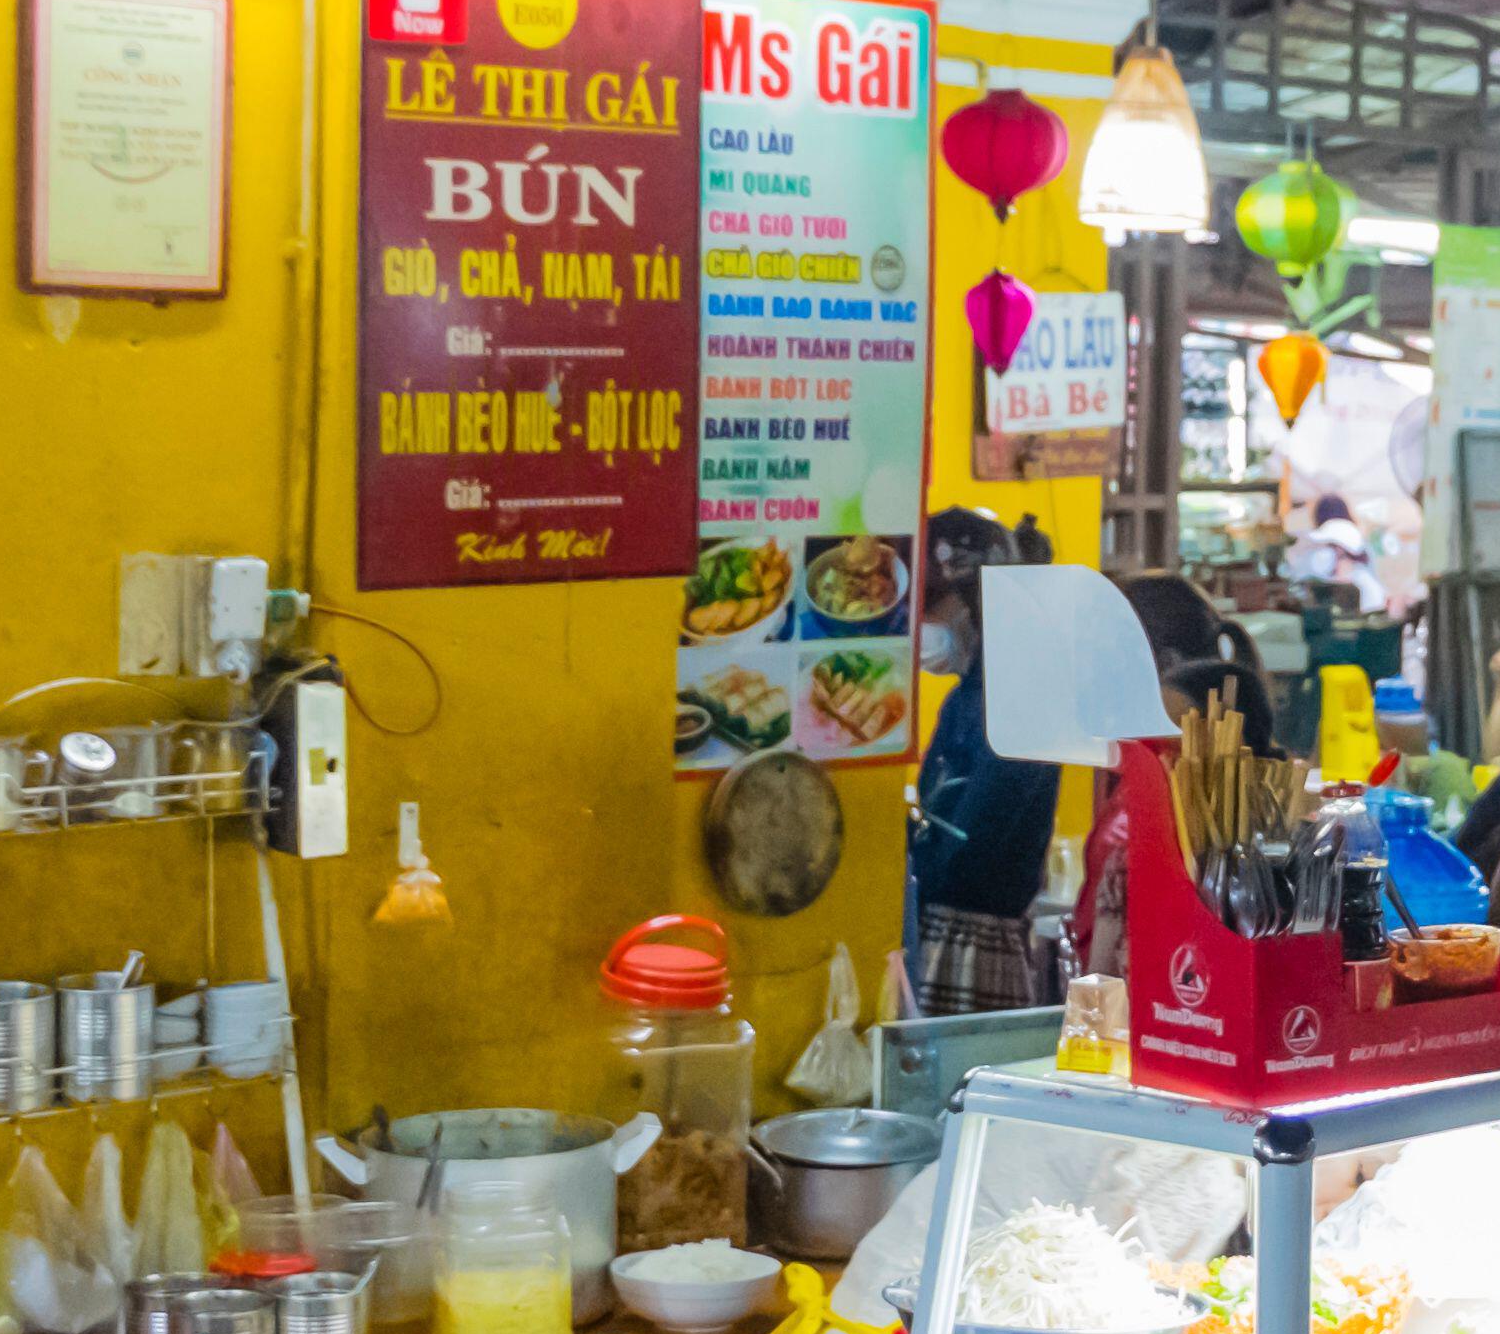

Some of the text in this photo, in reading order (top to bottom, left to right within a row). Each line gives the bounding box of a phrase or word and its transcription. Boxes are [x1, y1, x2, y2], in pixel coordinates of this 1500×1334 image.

[384, 47, 457, 116] LÊ
[585, 61, 681, 127] GÁI
[703, 9, 911, 110] Ms Gái
[708, 127, 749, 151] CAO
[423, 143, 644, 227] BÚN
[459, 233, 534, 306] CHẢ,
[632, 242, 681, 301] TÁI
[379, 377, 450, 454] BÁNH
[455, 375, 508, 454] BÈO
